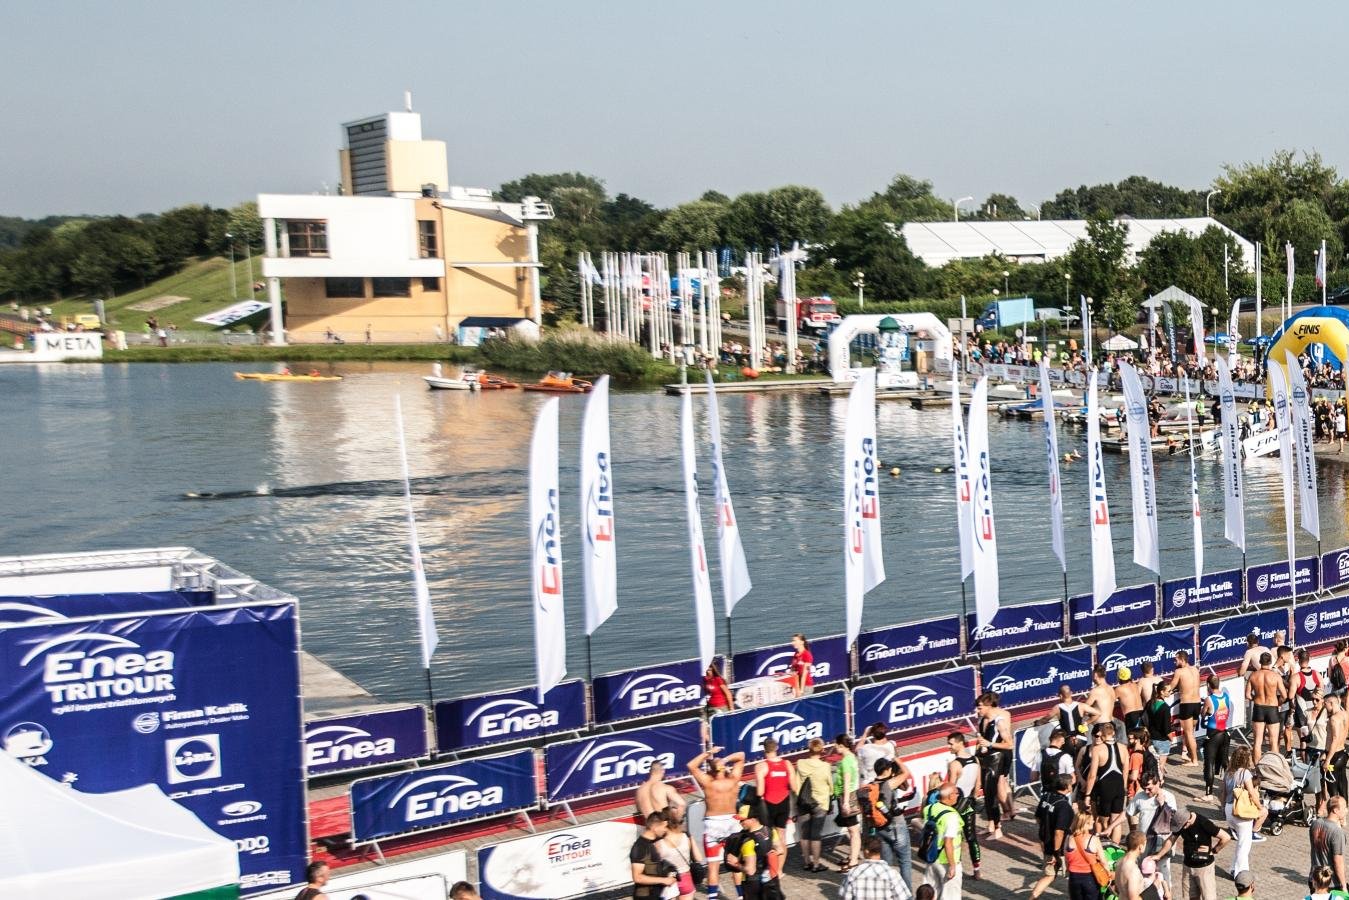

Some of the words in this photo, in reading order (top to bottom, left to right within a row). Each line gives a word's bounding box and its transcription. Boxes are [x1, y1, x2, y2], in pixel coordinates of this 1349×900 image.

[1298, 324, 1321, 335] FINIS
[46, 337, 97, 350] META
[862, 437, 878, 519] Enea
[1211, 581, 1233, 591] Karlik
[1271, 572, 1290, 582] Firma
[1074, 600, 1151, 619] ENDUSHOP
[1320, 610, 1341, 621] Firma
[1034, 620, 1061, 631] Triathlon
[866, 648, 896, 662] Enea
[928, 636, 957, 649] Triathlon
[1206, 639, 1232, 652] Enea
[43, 650, 175, 683] Enea
[1104, 658, 1135, 672] Enea
[45, 674, 176, 703] TRITOUR
[991, 679, 1024, 695] Enea
[1058, 668, 1090, 681] Triathlon
[630, 683, 702, 710] Enea
[162, 707, 204, 722] Firma
[205, 702, 249, 717] Karlik
[209, 715, 231, 725] Dealer
[889, 696, 954, 724] Enea
[477, 709, 559, 738] Enea
[749, 721, 823, 752] Enea
[305, 737, 396, 767] Enea
[592, 751, 675, 784] Enea
[404, 785, 504, 822] Enea
[548, 838, 591, 856] Enea
[548, 848, 592, 864] TRITOUR
